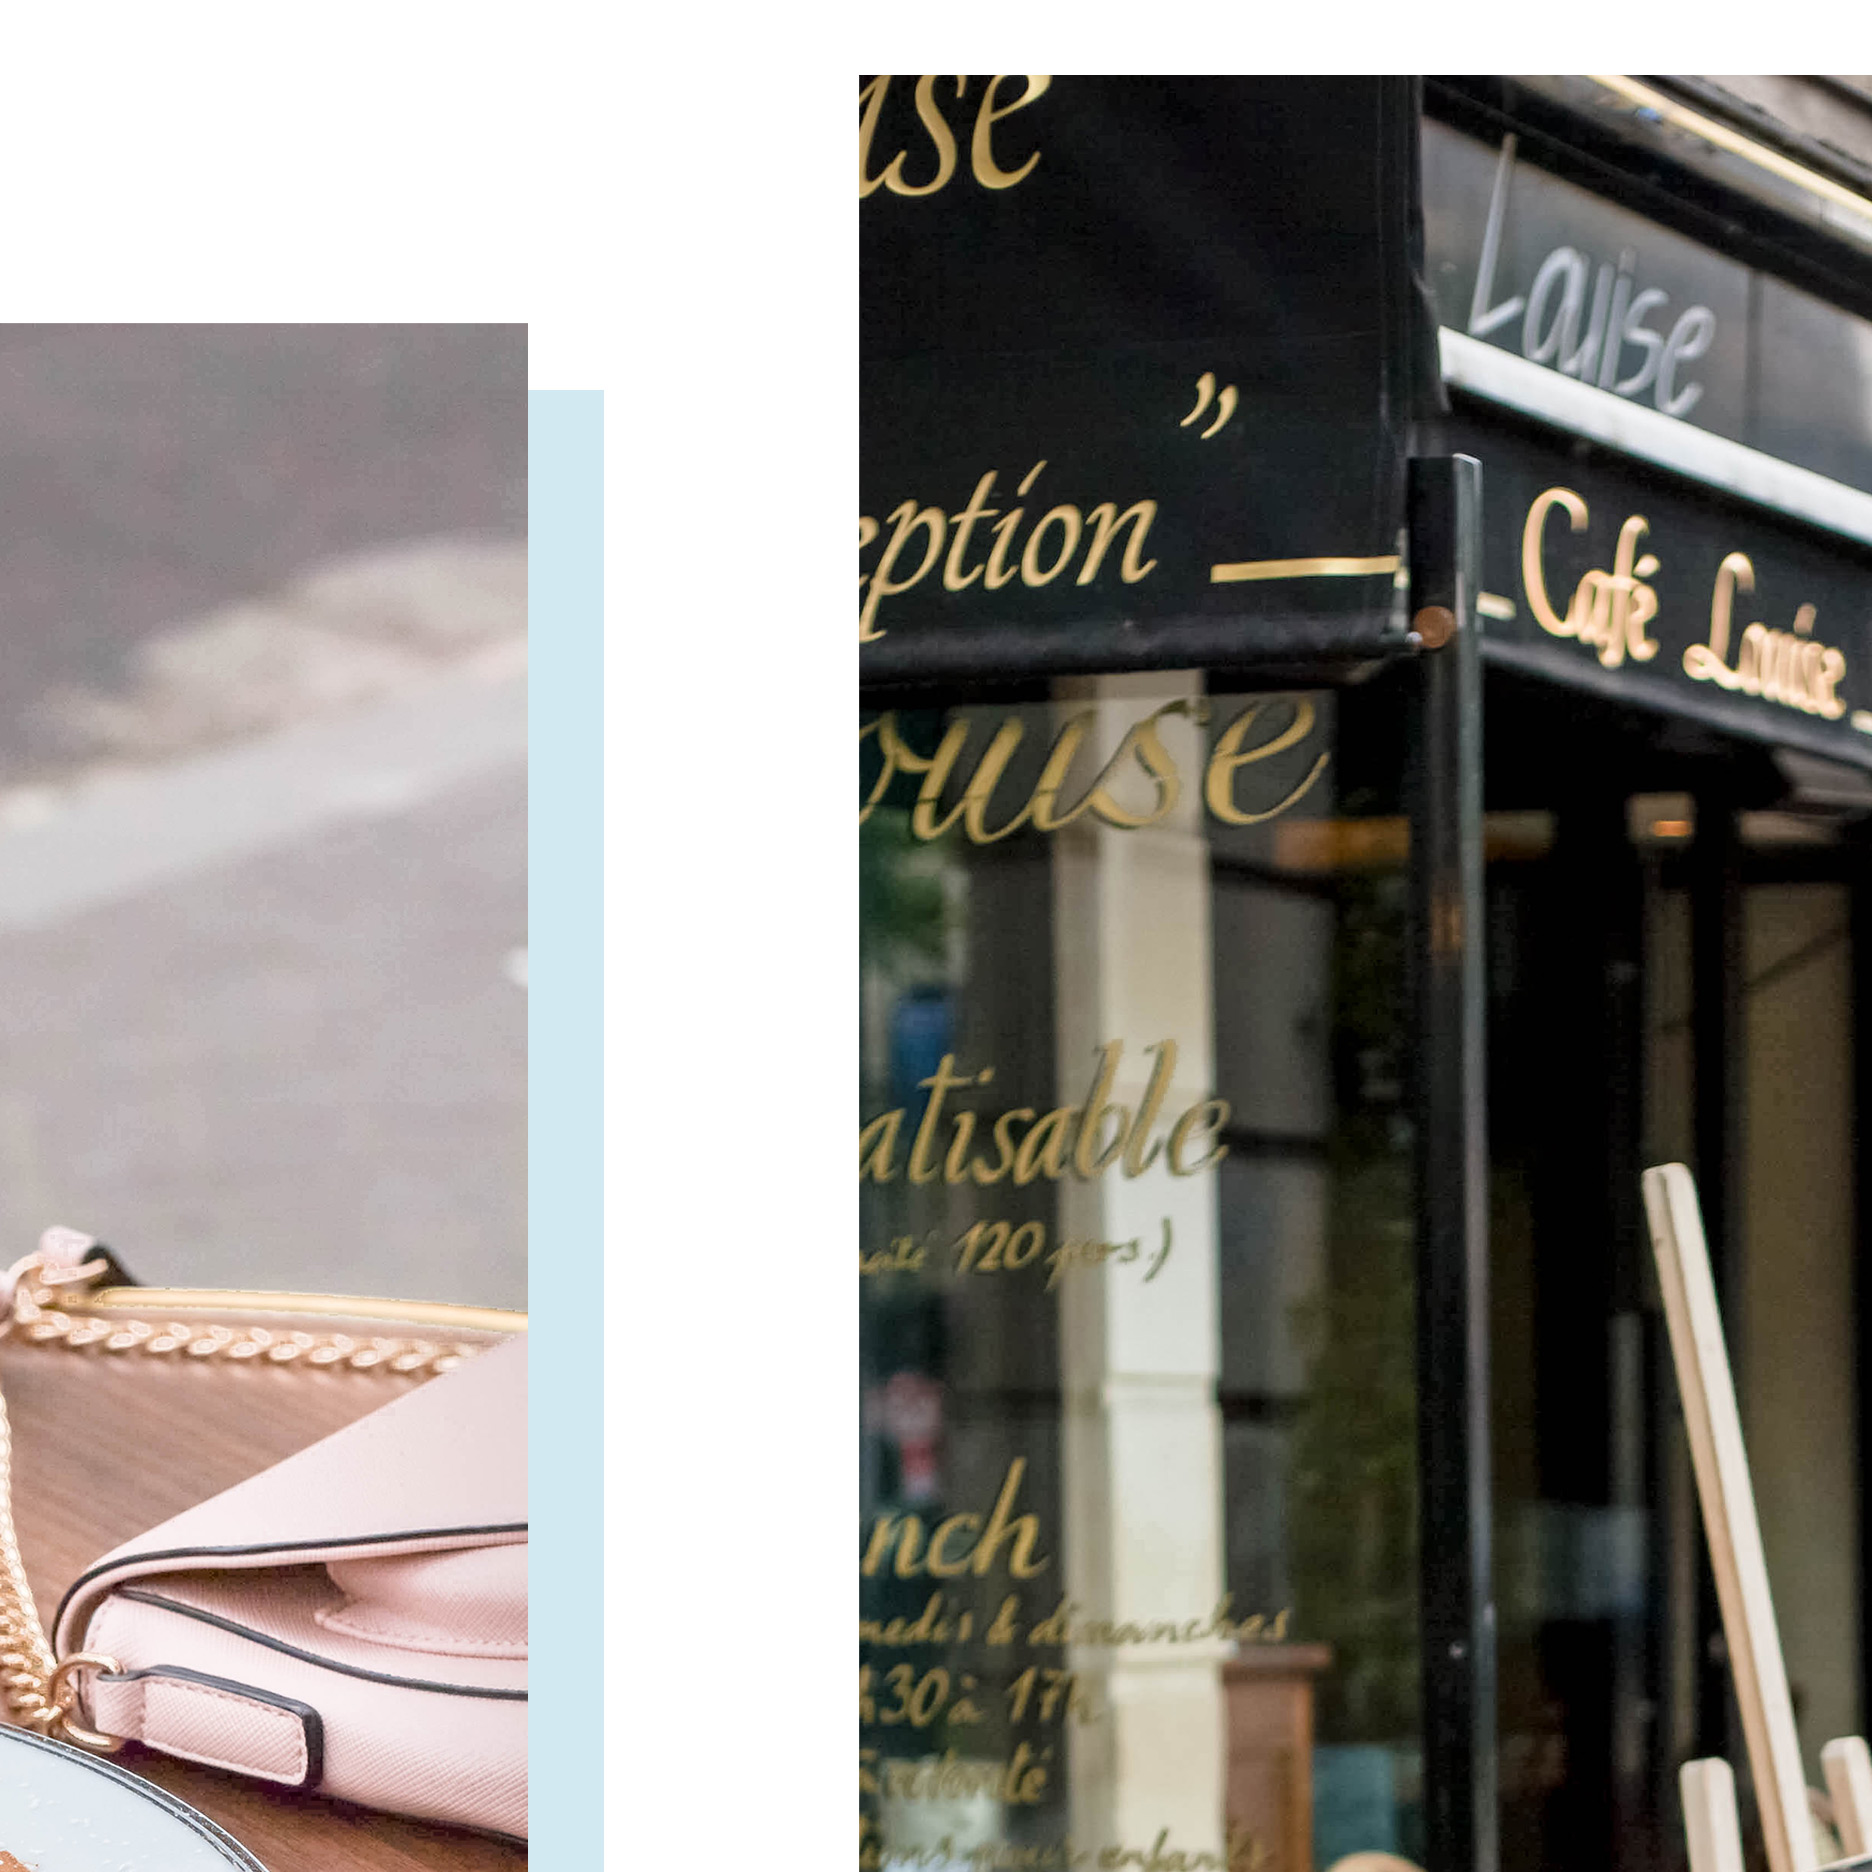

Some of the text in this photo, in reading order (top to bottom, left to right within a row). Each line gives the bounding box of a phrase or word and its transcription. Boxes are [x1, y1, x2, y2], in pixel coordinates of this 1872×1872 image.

[1522, 486, 1847, 721] Café Louise
[954, 1219, 1047, 1277] 120
